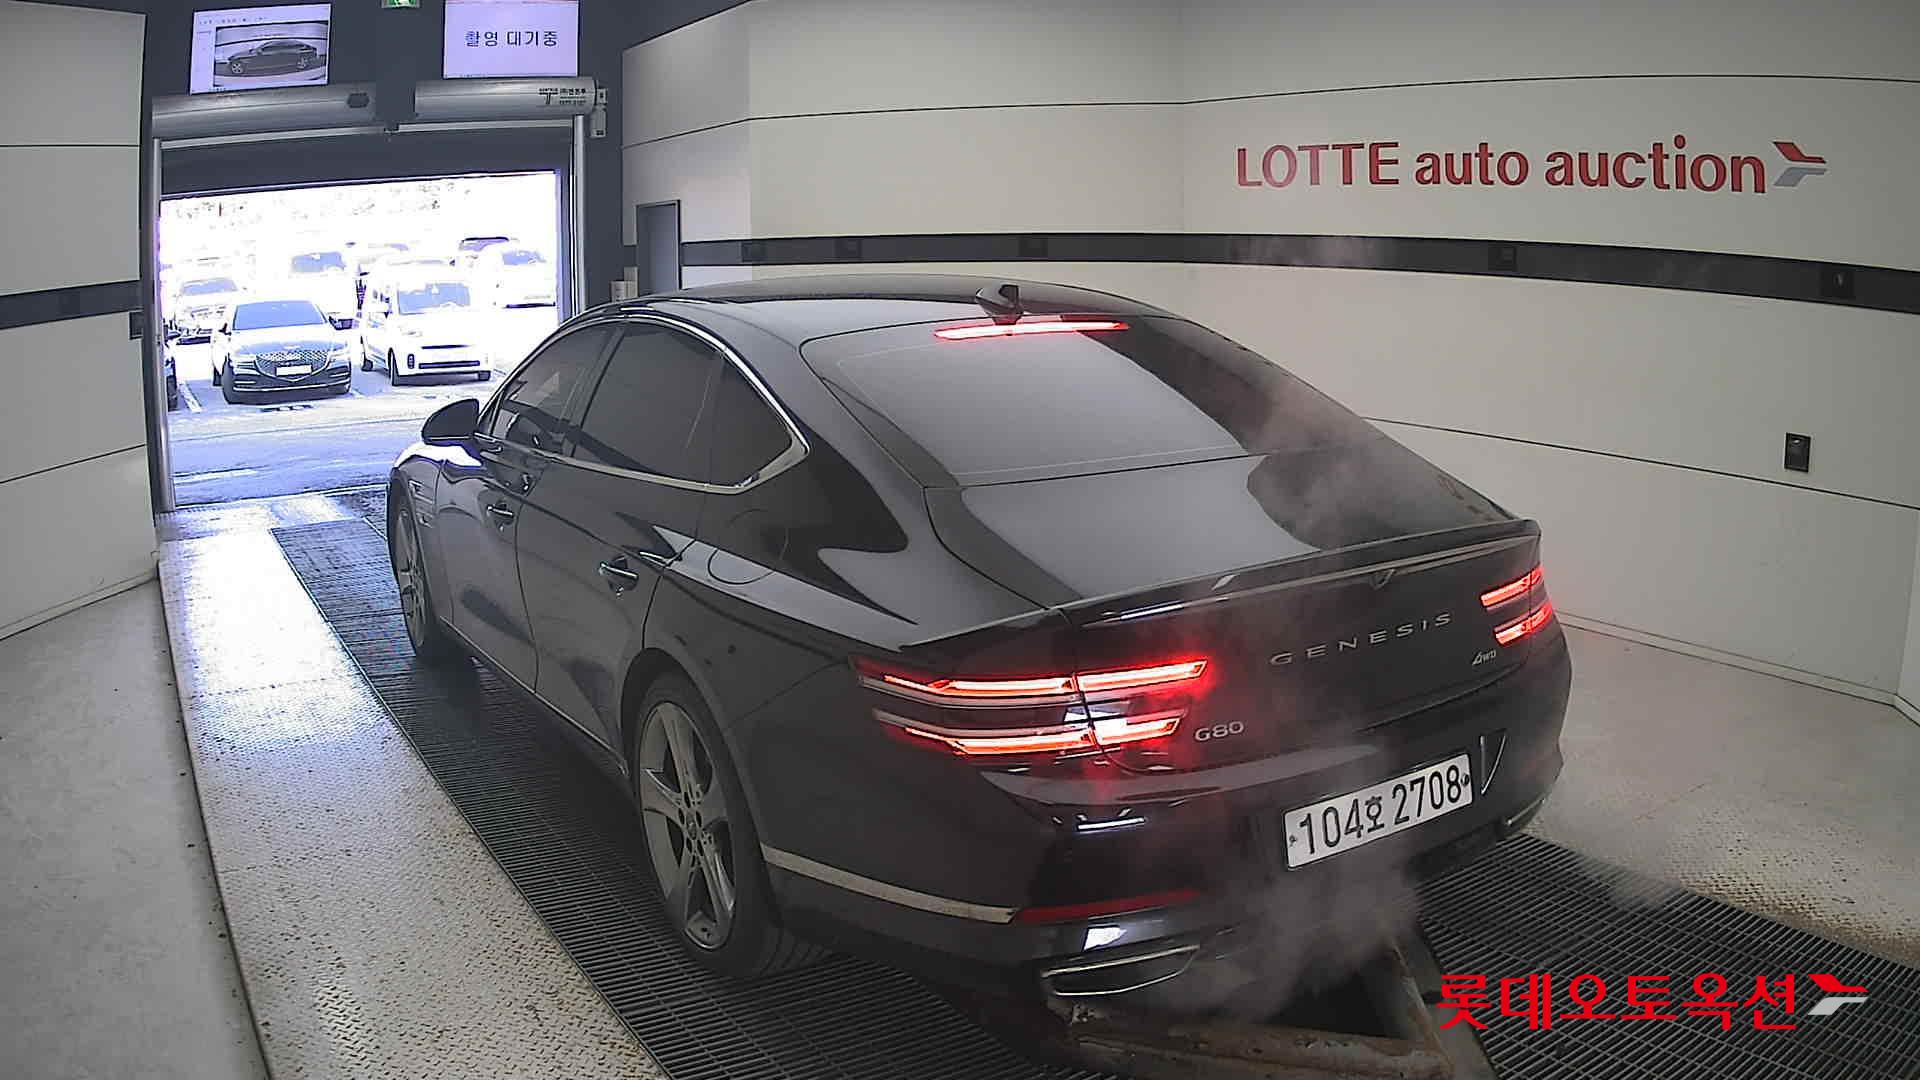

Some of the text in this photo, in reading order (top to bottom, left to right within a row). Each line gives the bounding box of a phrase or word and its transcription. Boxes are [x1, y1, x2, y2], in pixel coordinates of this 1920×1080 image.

[1237, 134, 1767, 194] LOTTE auto auction
[1269, 613, 1452, 666] GENESIS
[1194, 720, 1245, 742] G80
